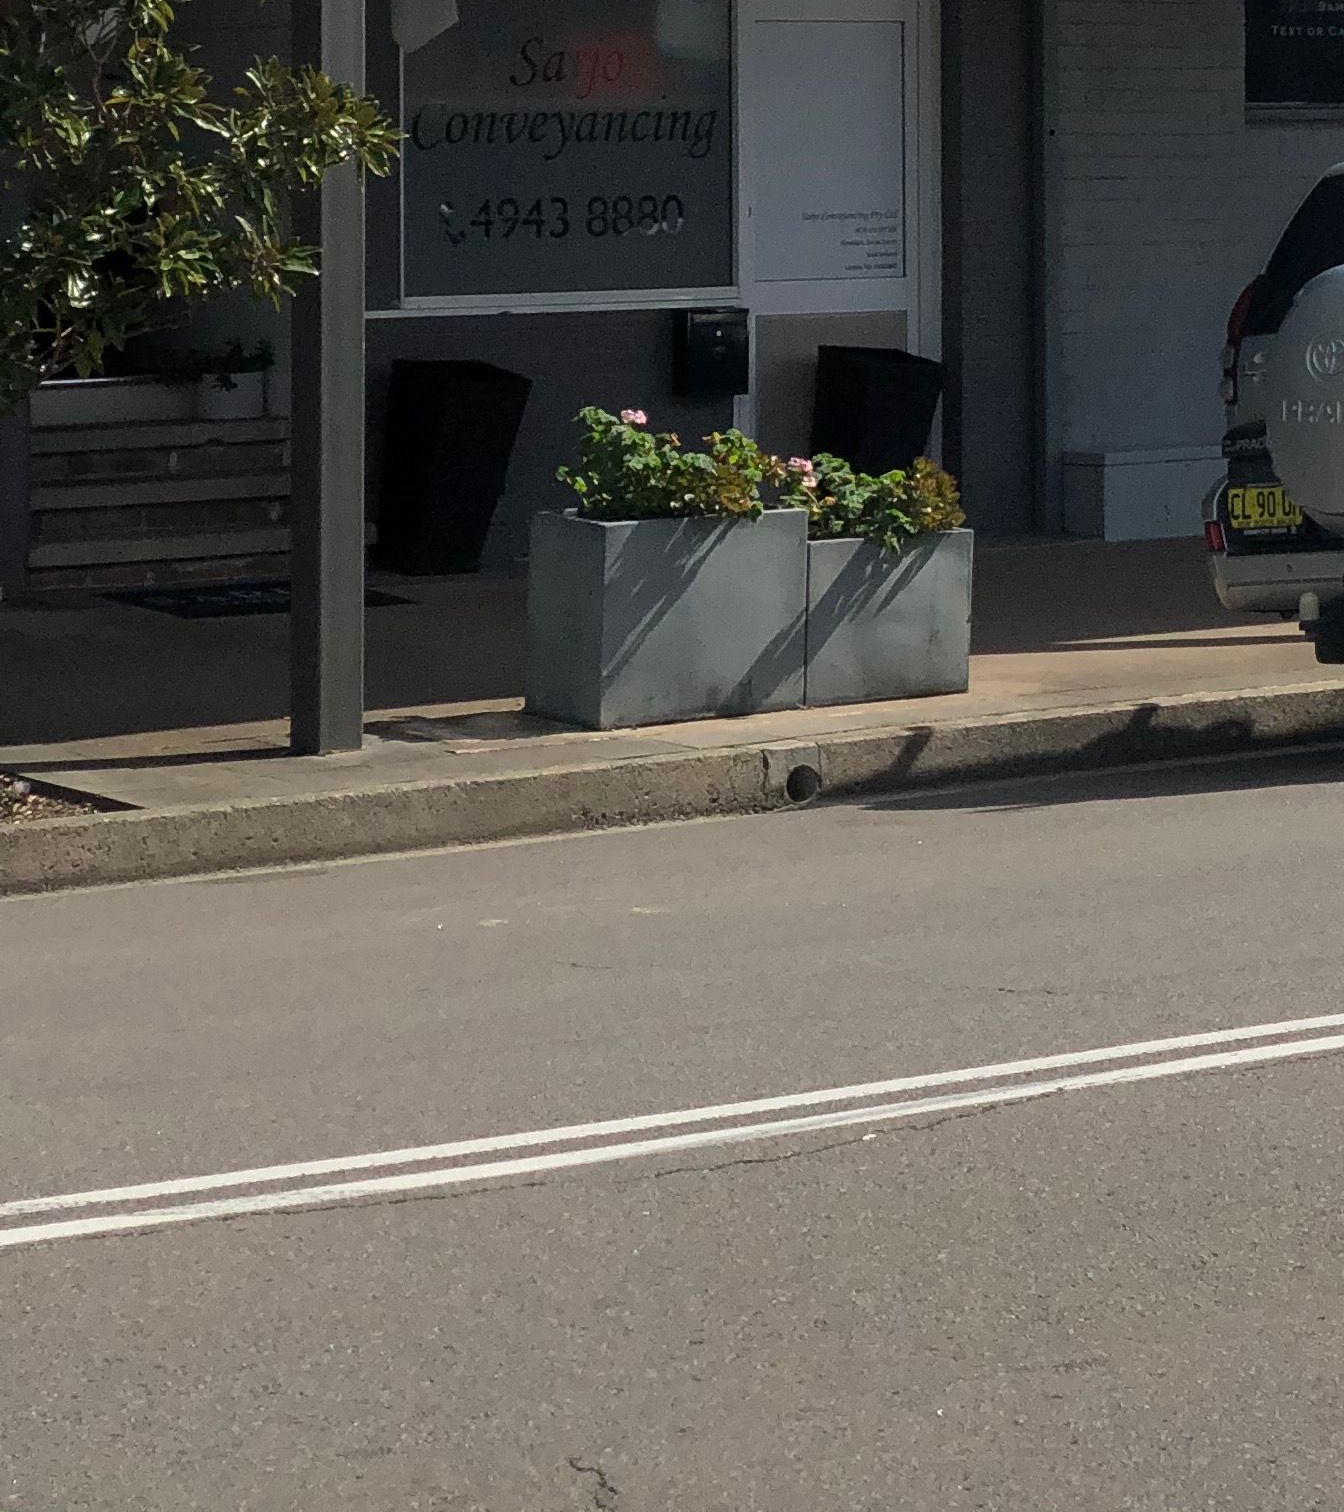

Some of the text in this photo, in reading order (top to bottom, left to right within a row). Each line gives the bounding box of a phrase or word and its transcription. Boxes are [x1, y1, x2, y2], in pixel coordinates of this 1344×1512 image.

[411, 93, 719, 160] Conveyancing
[469, 194, 685, 239] 4943 8880
